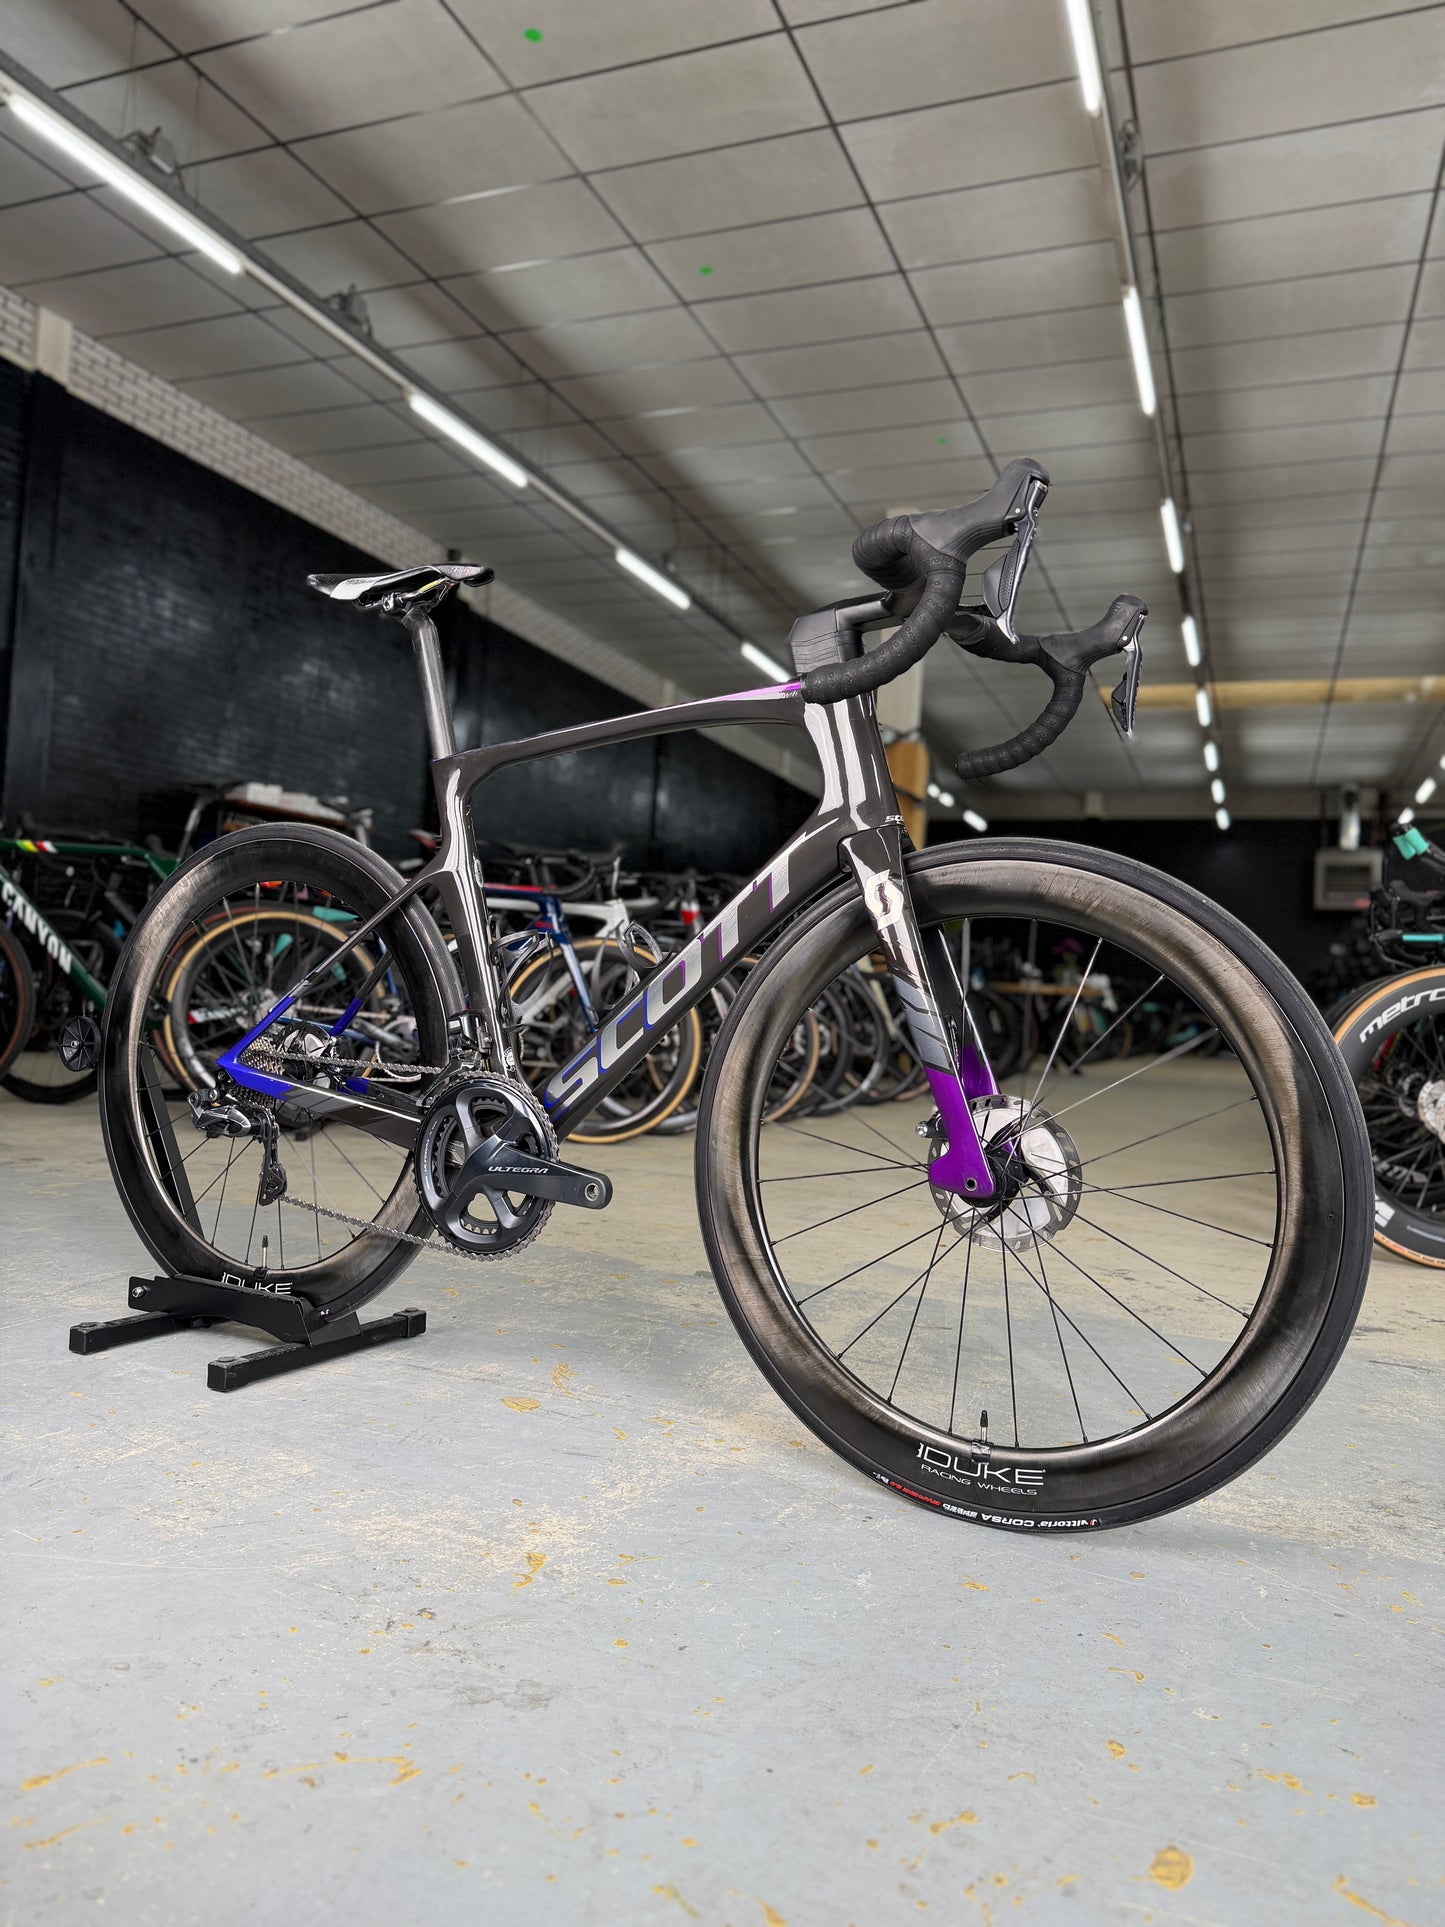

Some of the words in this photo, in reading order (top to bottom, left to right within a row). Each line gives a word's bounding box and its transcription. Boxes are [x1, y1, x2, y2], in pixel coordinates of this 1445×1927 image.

[2, 881, 72, 975] CANYON
[545, 832, 806, 1110] SCOTT
[488, 1166, 549, 1174] ULTEGRA
[917, 1442, 1046, 1485] DUKE
[921, 1463, 971, 1486] RACING
[977, 1482, 1038, 1496] WHEELS
[981, 1513, 1034, 1527] CORSA
[1037, 1519, 1089, 1528] vittoria
